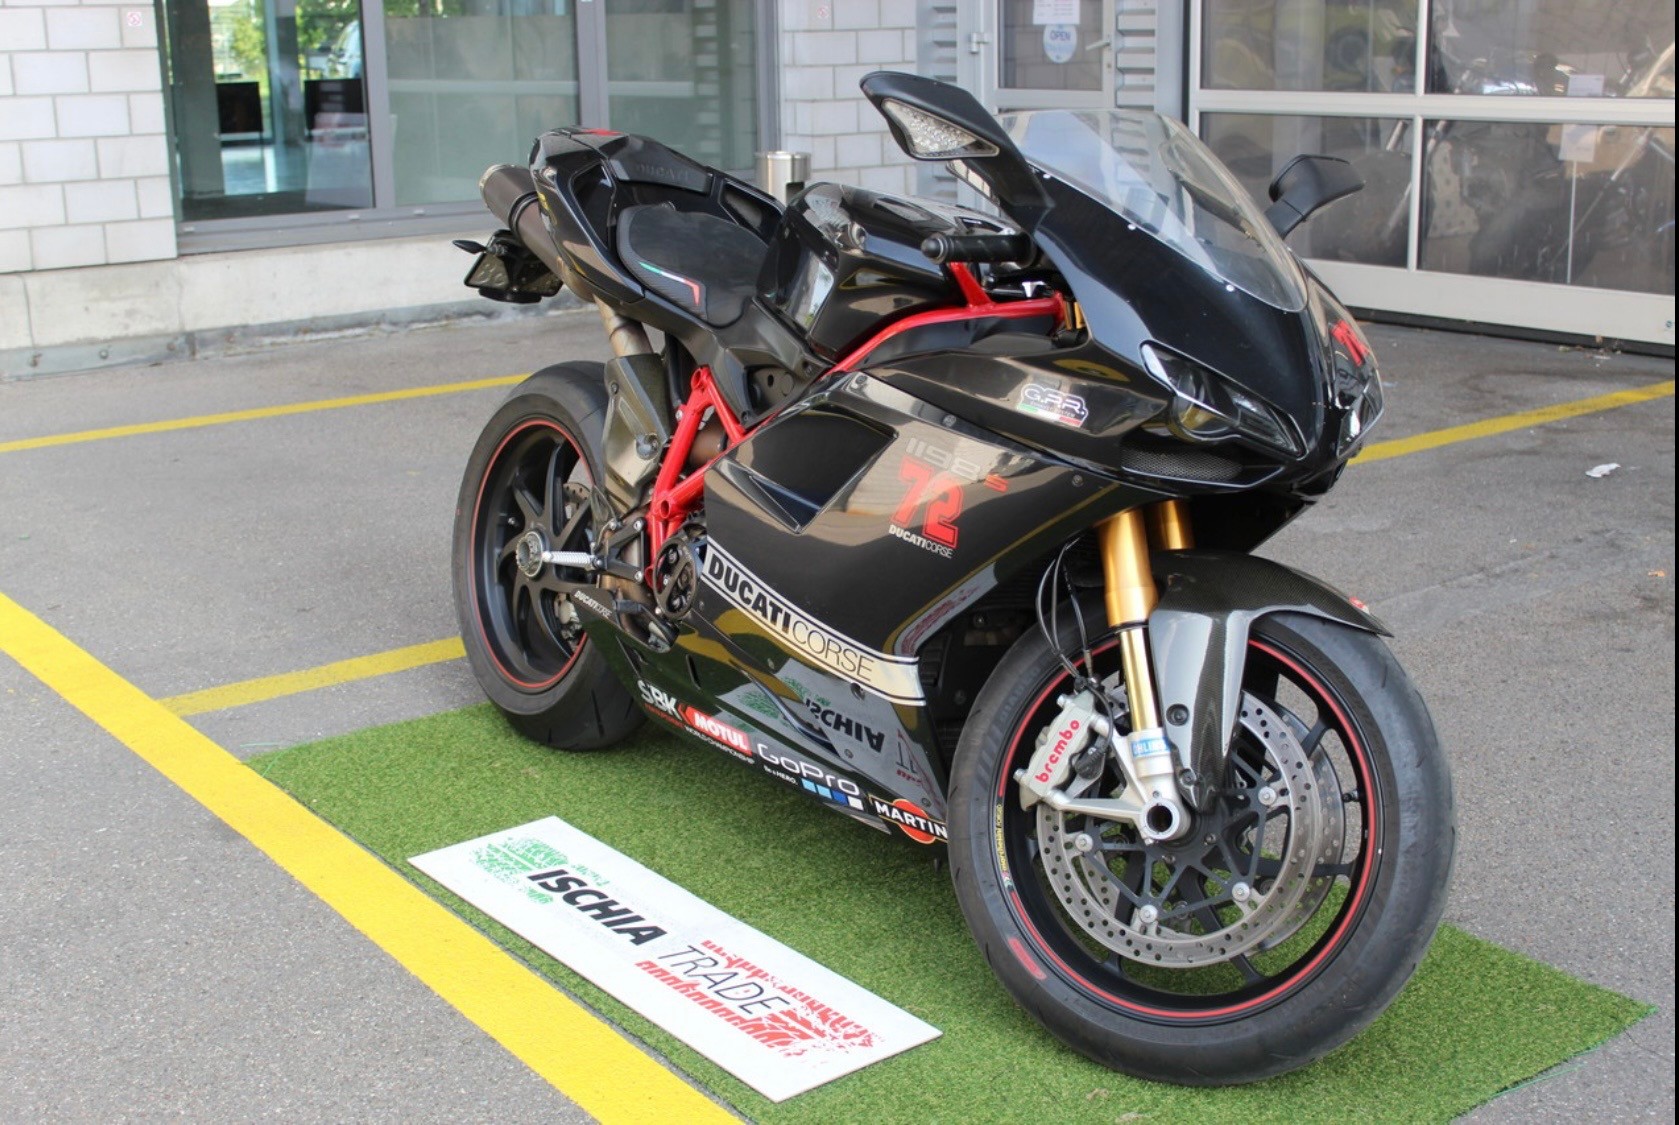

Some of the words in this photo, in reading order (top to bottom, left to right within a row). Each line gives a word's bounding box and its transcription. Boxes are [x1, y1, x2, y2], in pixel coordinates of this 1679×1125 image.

[1050, 30, 1071, 41] OPEN
[905, 437, 980, 481] 1198
[889, 454, 964, 550] 72
[637, 680, 683, 721] SBK
[694, 712, 748, 752] MOTUL
[1034, 720, 1080, 783] brembo
[757, 743, 860, 796] GoPro
[874, 801, 948, 838] MARTIN
[528, 869, 667, 946] ISCHIA
[658, 944, 790, 1015] TRADE
